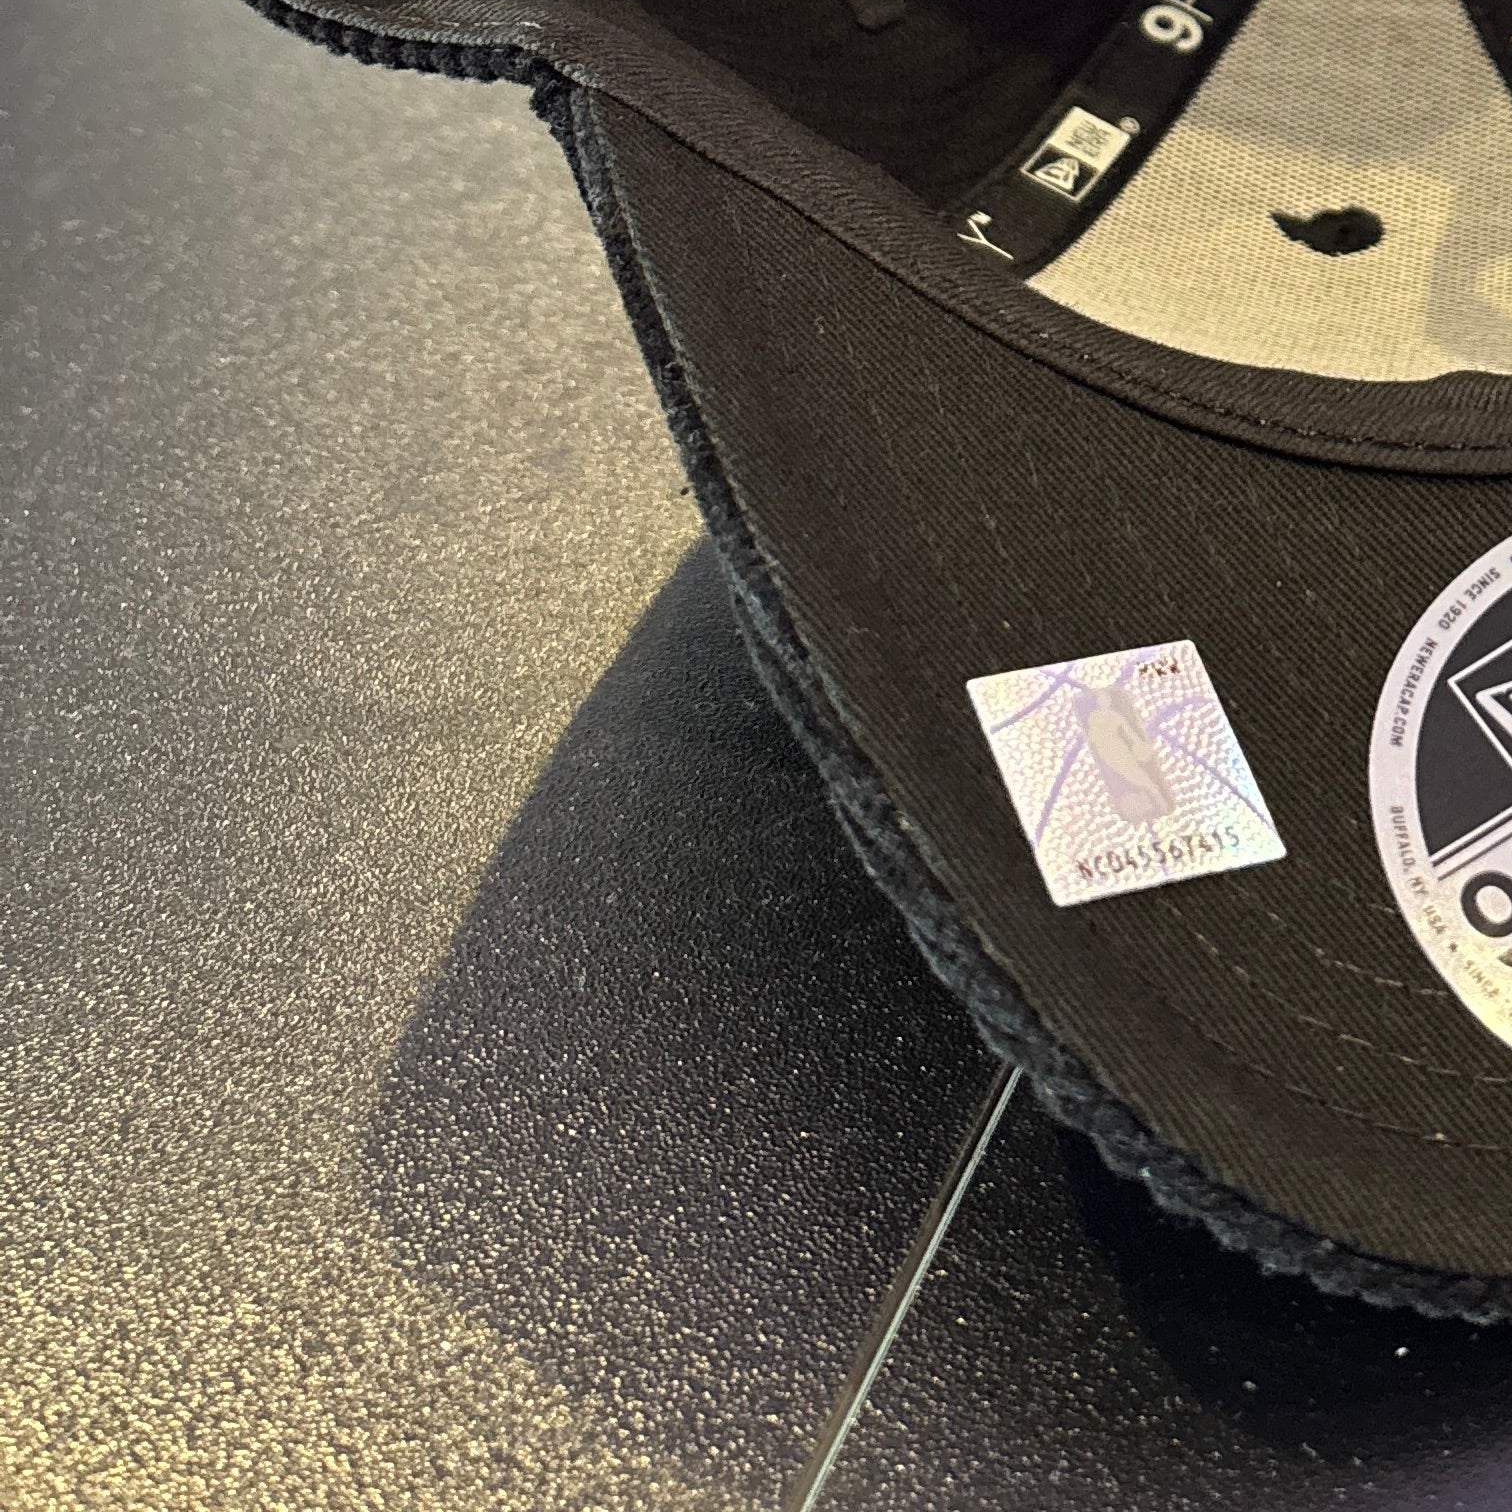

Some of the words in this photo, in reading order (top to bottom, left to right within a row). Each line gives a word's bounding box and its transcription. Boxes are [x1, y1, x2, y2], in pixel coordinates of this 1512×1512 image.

[1468, 567, 1501, 602] SINCE
[1437, 601, 1468, 631] 1920
[1389, 637, 1439, 747] NEWERACAP.COM
